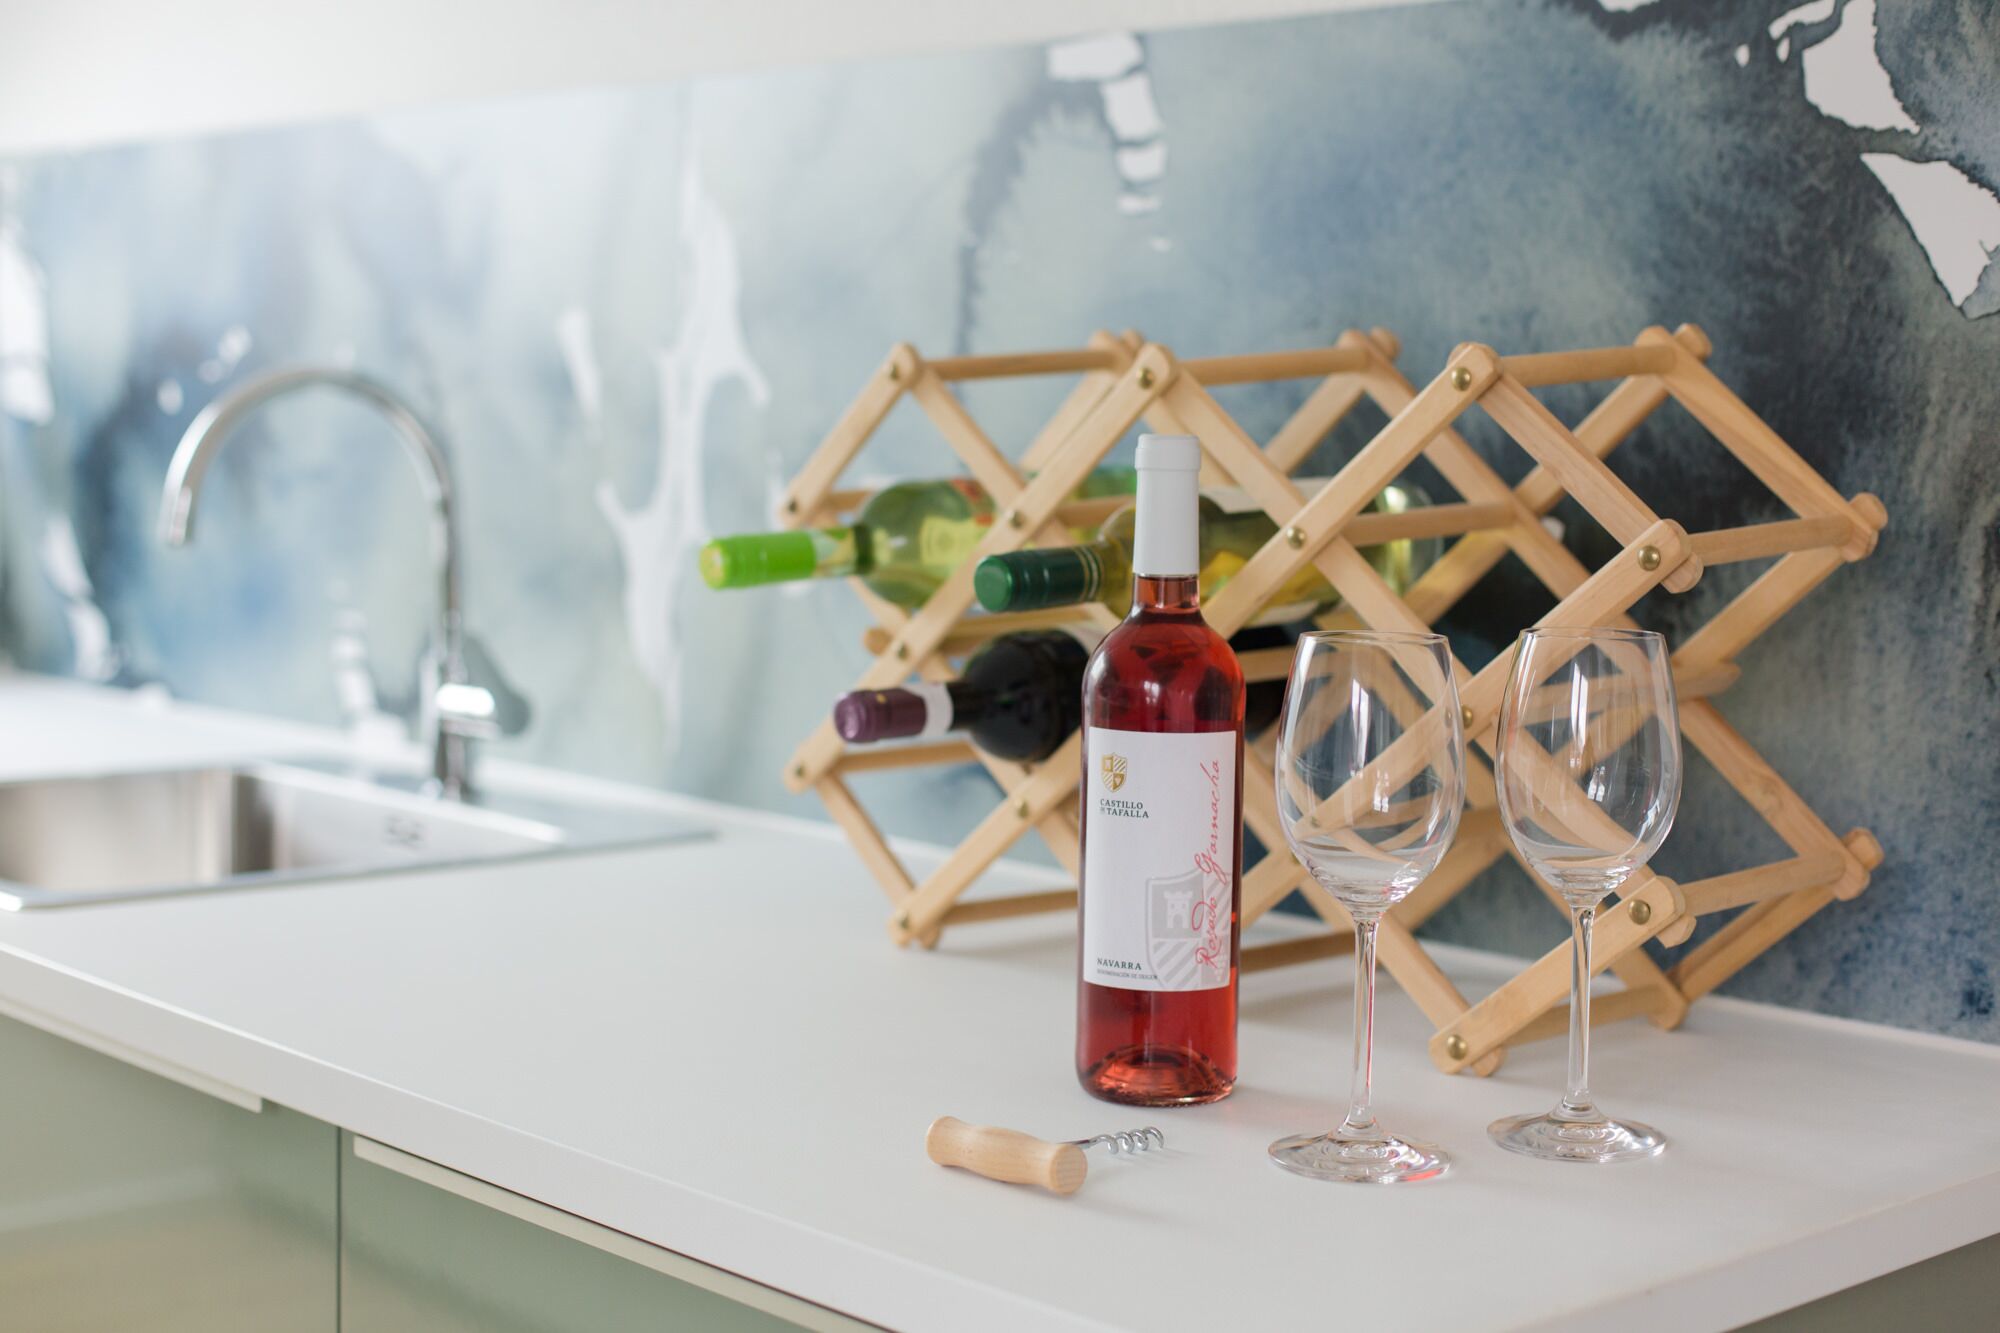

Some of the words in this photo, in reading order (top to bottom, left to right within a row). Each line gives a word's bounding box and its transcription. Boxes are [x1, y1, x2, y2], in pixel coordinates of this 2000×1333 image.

[1100, 798, 1143, 809] CASTILLO
[1106, 807, 1149, 818] TAFALLA
[1194, 759, 1228, 885] Garnacha
[1097, 958, 1142, 970] NAVARRA
